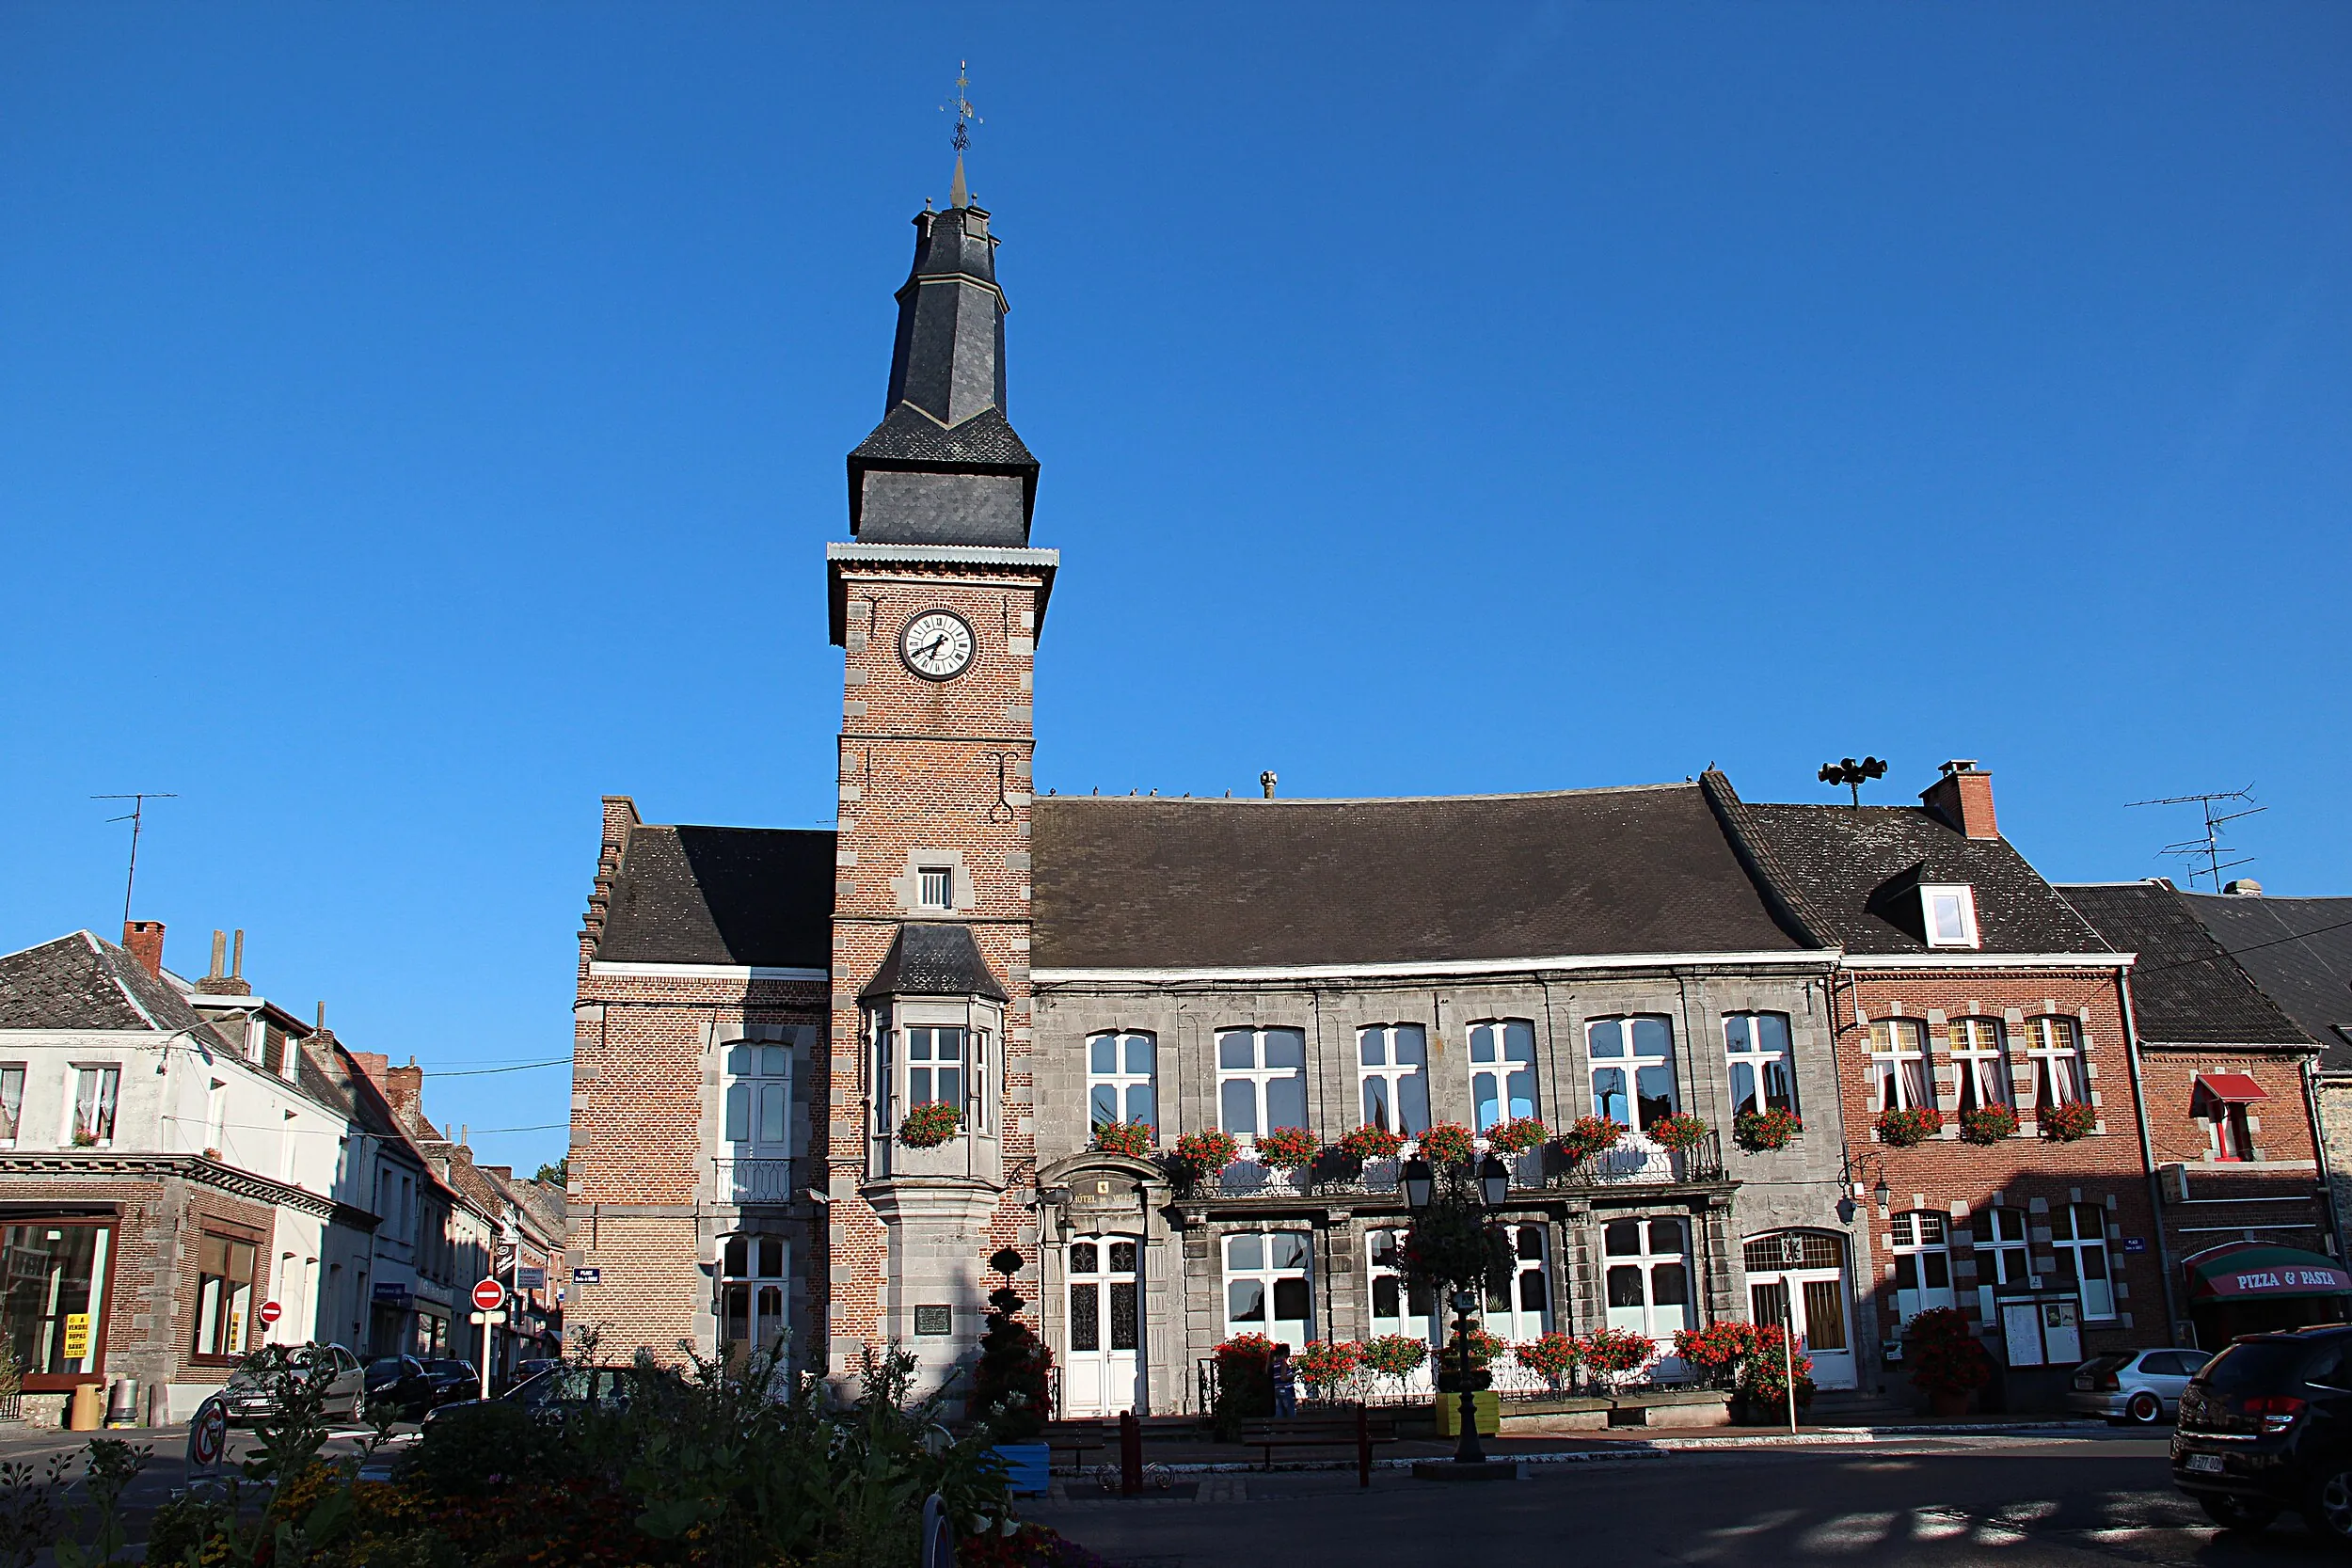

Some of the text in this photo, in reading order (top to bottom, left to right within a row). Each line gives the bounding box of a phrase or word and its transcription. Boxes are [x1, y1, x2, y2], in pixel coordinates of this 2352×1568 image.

[1112, 1194, 1134, 1203] VILLE
[2237, 1271, 2336, 1290] PIZZA & PASTA
